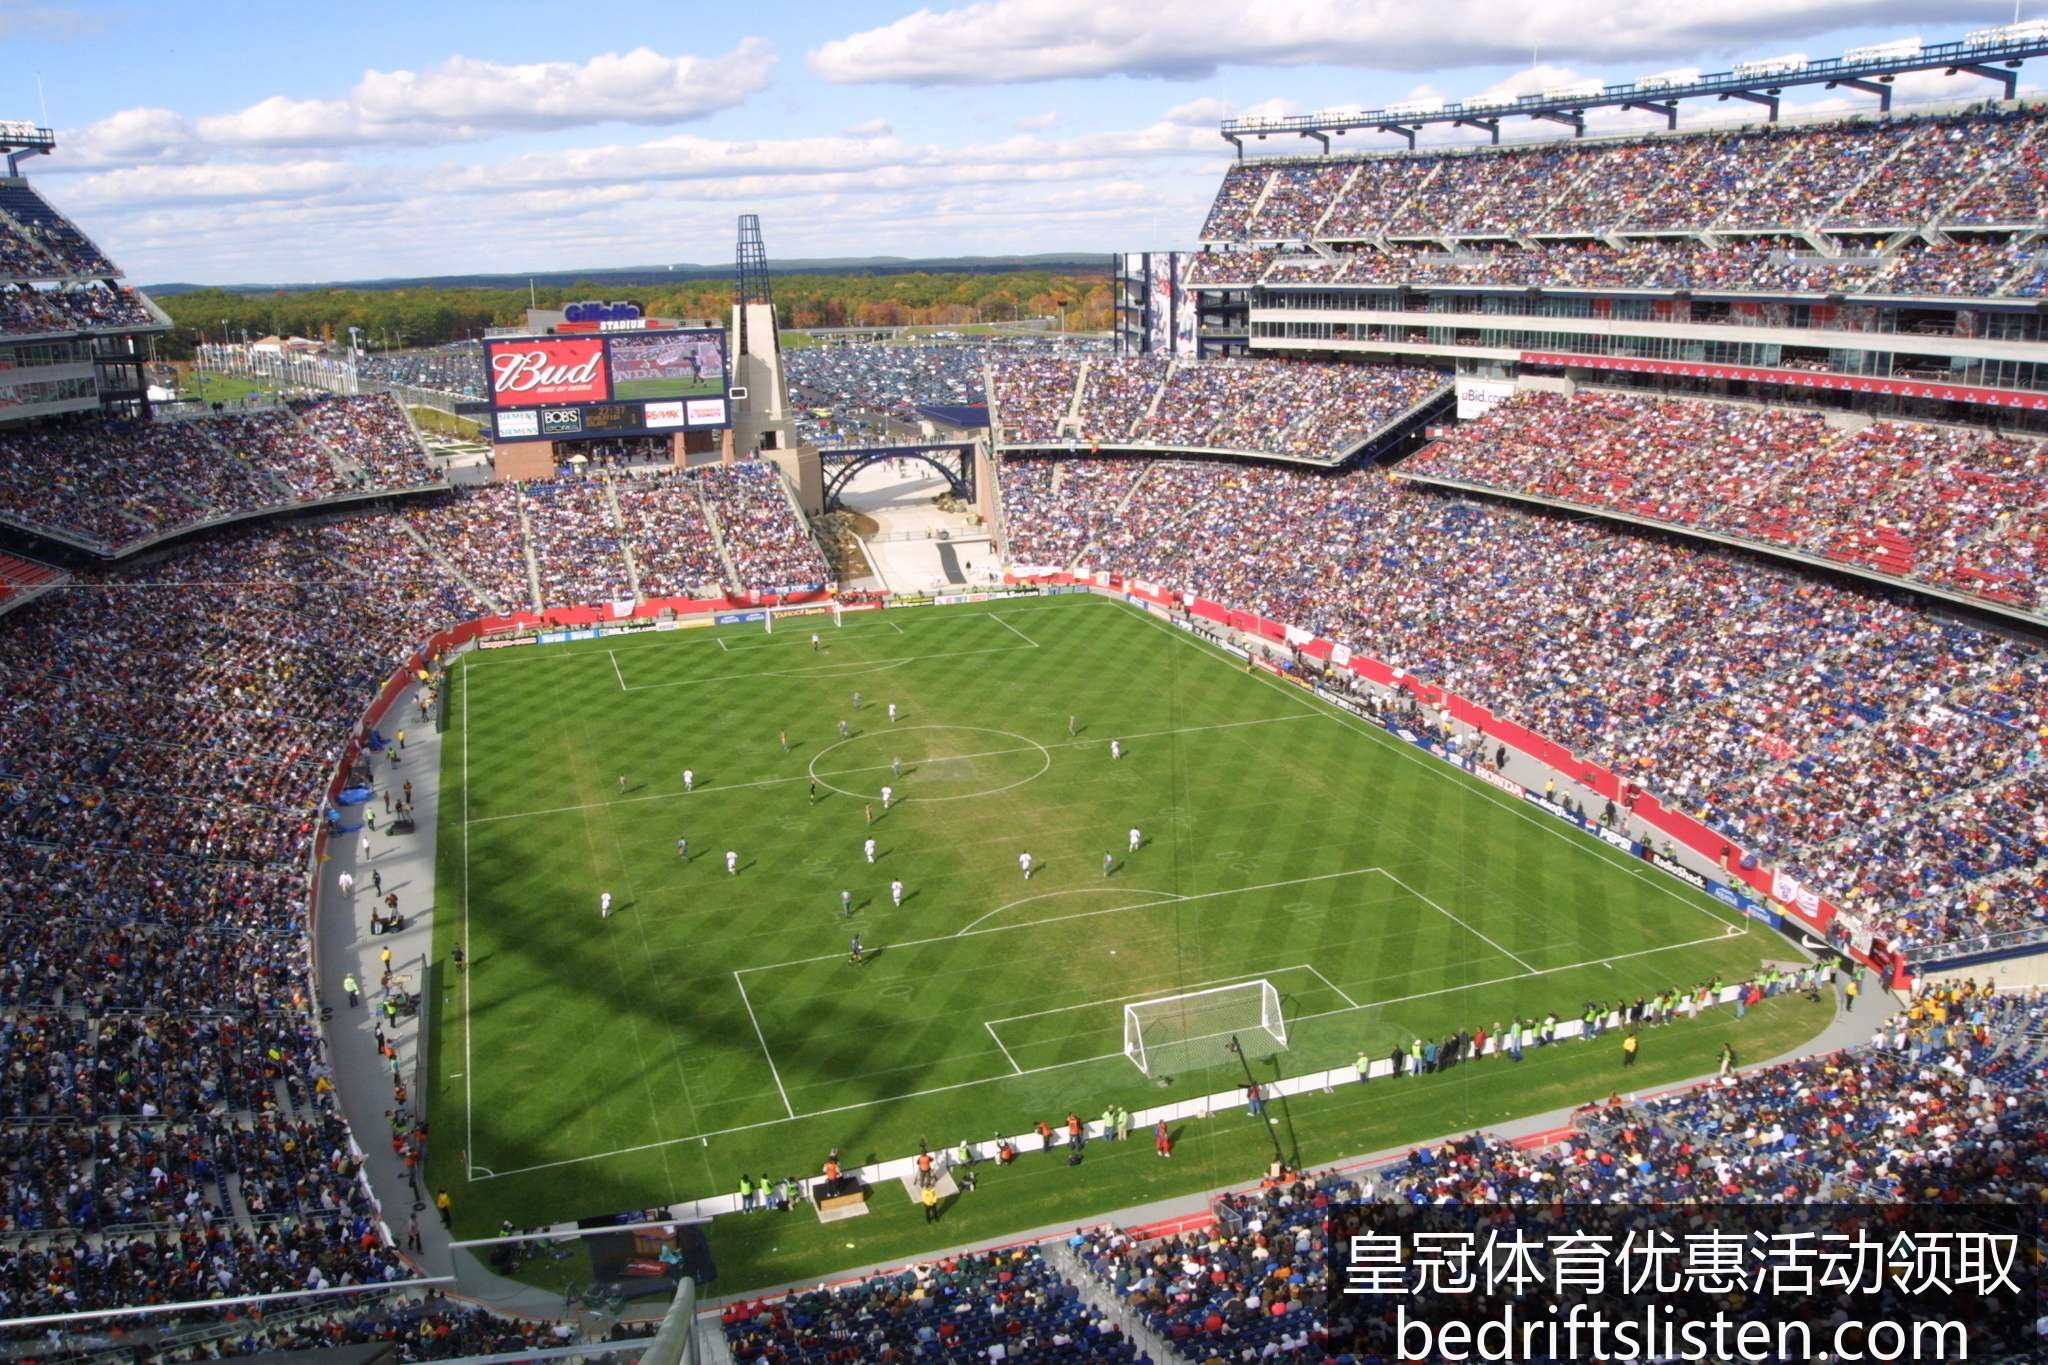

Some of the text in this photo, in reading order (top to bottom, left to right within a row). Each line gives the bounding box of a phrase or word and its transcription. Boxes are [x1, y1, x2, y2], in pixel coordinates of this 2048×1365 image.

[563, 301, 640, 323] Gillette
[600, 320, 646, 330] STADIUM
[491, 351, 603, 393] Bud
[544, 411, 578, 424] BOB'S
[1475, 764, 1525, 798] HONDA
[1600, 827, 1633, 851] PEPSI
[1653, 853, 1706, 889] RadioShack
